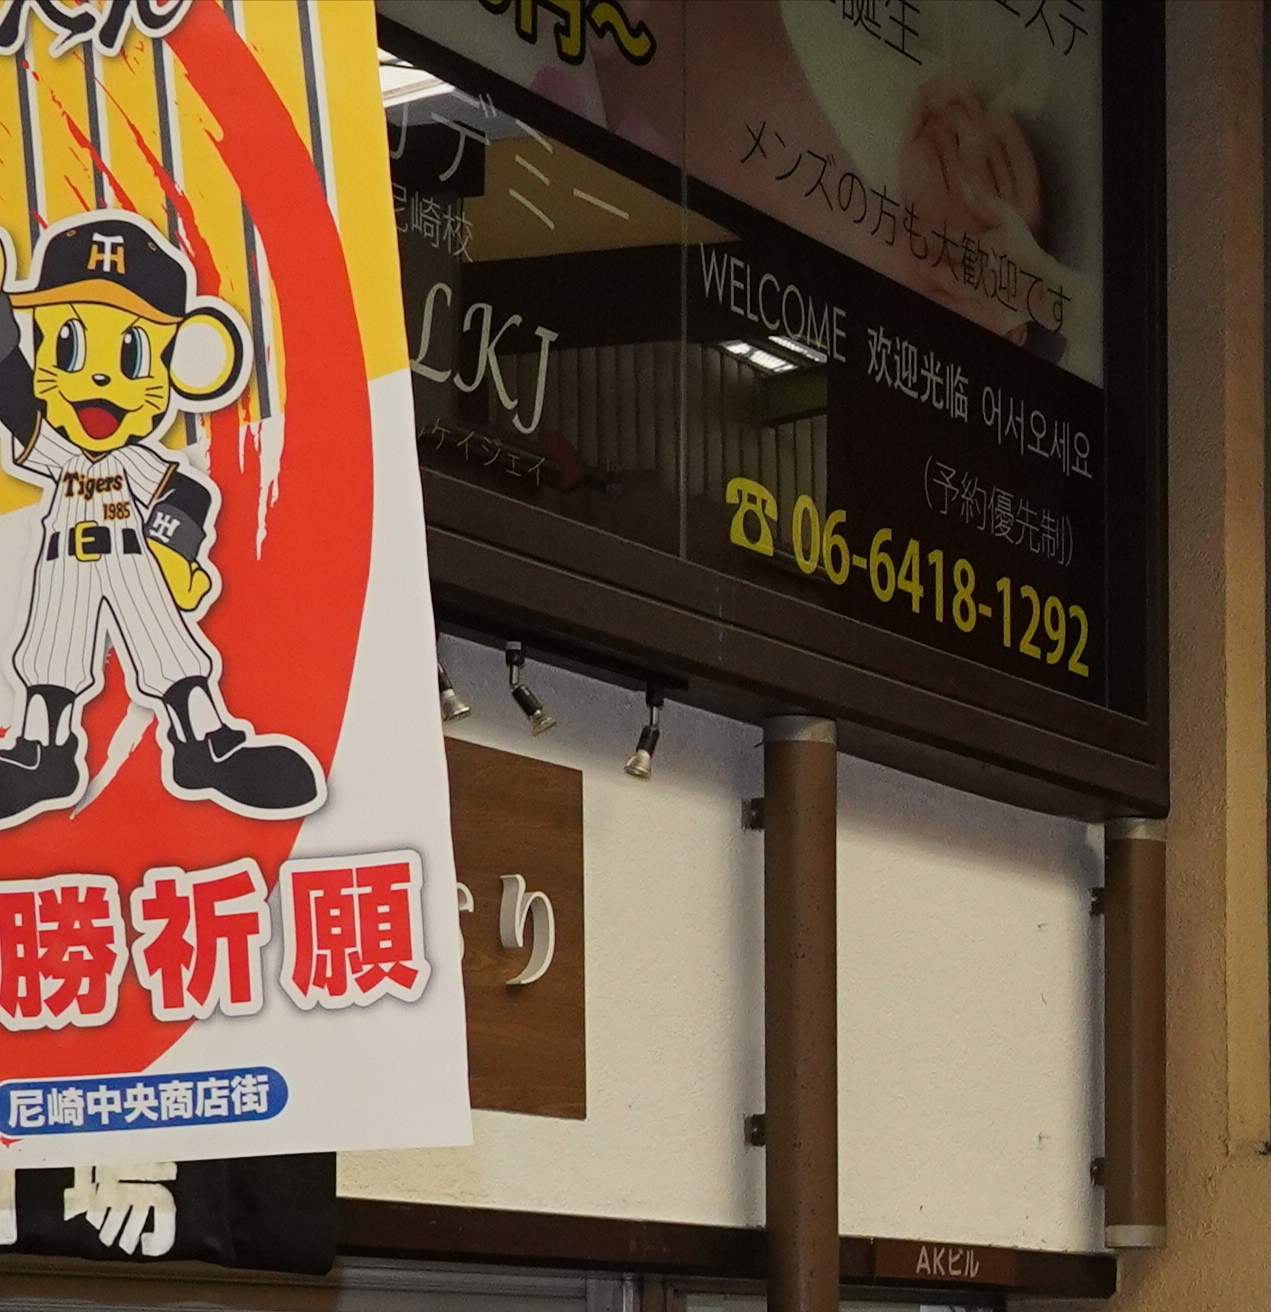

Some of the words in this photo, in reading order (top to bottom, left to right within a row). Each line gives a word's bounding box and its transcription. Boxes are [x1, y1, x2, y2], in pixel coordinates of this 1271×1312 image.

[391, 94, 629, 230] デミー
[739, 119, 1073, 334] メンズの方も大歓迎です
[410, 281, 559, 435] LKJ
[699, 242, 848, 364] WELCOME
[866, 325, 970, 423] 欢迎光临
[980, 384, 1093, 480] 어서오세요
[63, 472, 124, 499] Tigers
[102, 501, 132, 520] 1985
[418, 424, 548, 487] ケイジェイ
[922, 455, 1075, 568] (予約優先制)
[792, 493, 1091, 679] 06-6418-1292
[0, 862, 421, 1018] 勝祈願
[7, 1073, 271, 1129] 尼崎中央商店街
[915, 1245, 981, 1279] AKビル
